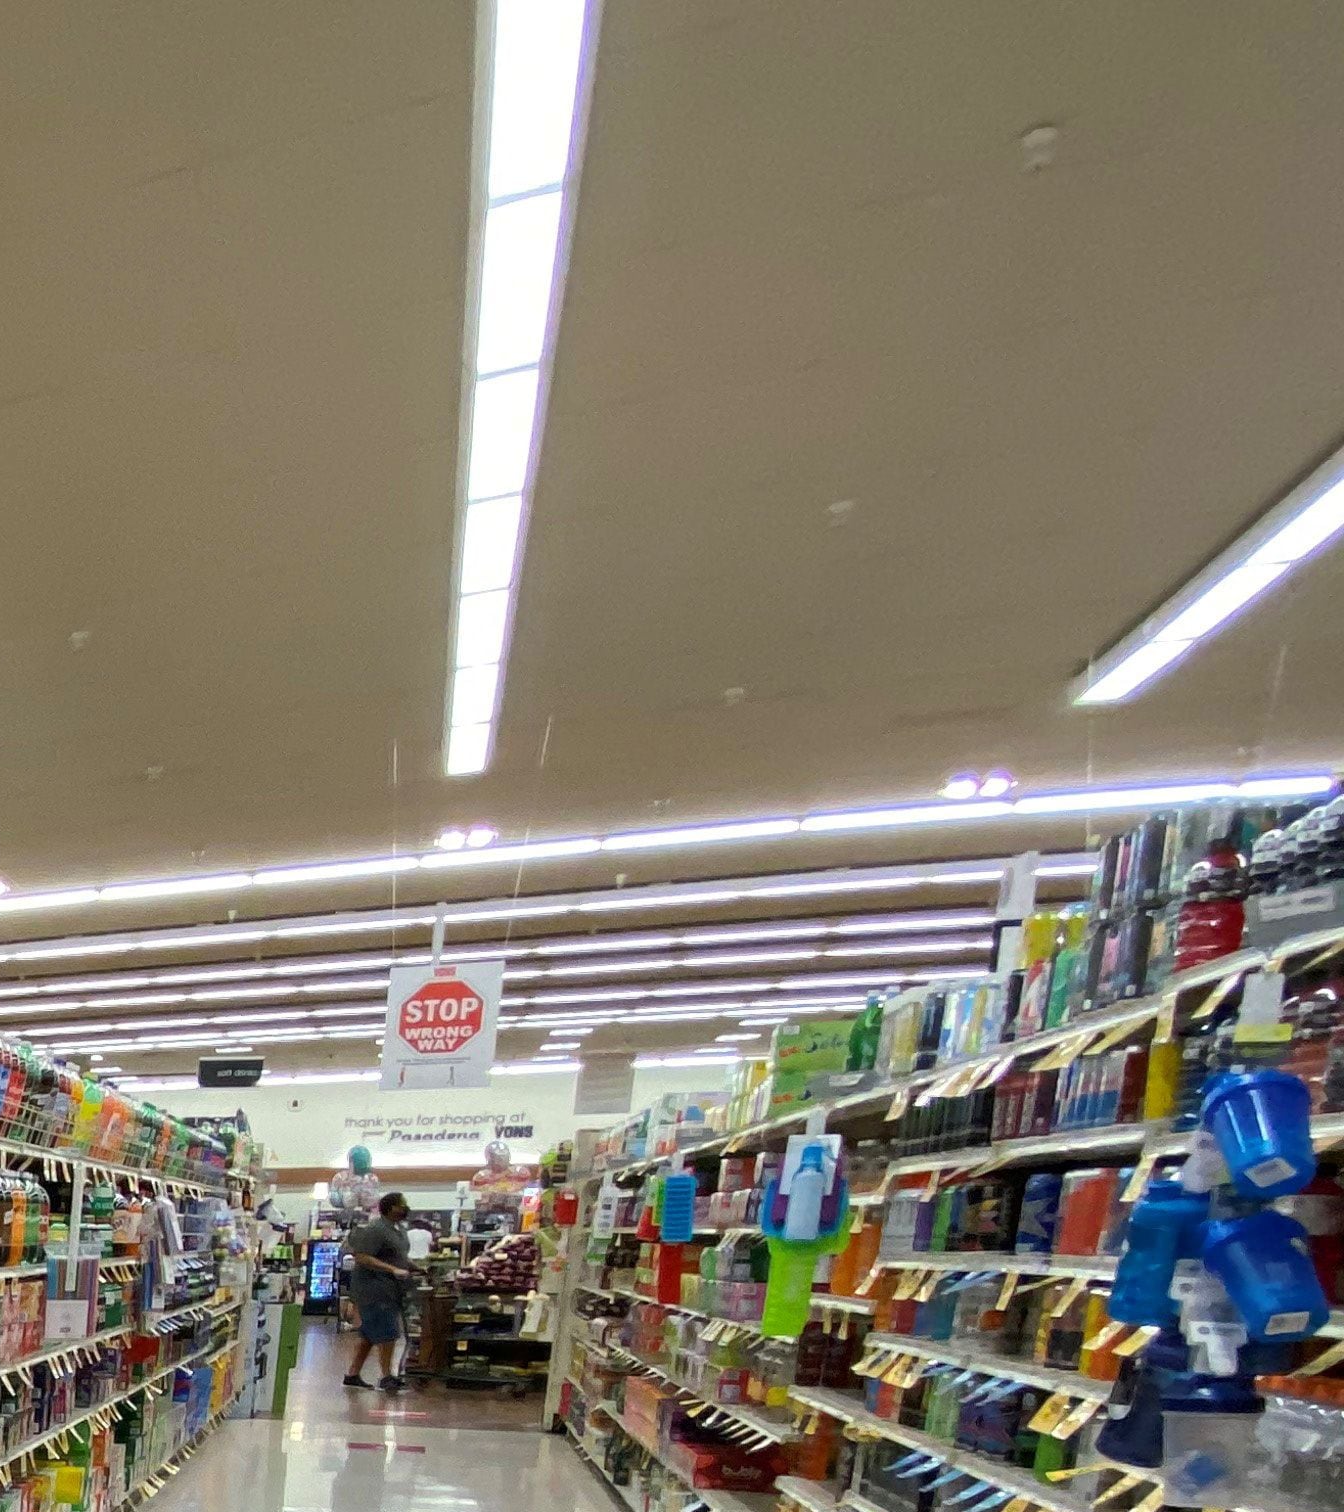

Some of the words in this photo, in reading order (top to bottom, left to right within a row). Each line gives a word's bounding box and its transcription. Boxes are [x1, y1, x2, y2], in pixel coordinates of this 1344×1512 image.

[405, 996, 479, 1023] STOP
[404, 1025, 474, 1040] WRONG
[416, 1038, 457, 1050] WAY
[344, 1116, 383, 1128] thank
[387, 1117, 412, 1128] you
[416, 1114, 436, 1126] for
[439, 1112, 505, 1126] shopping
[510, 1111, 527, 1122] at
[494, 1125, 533, 1138] VONS
